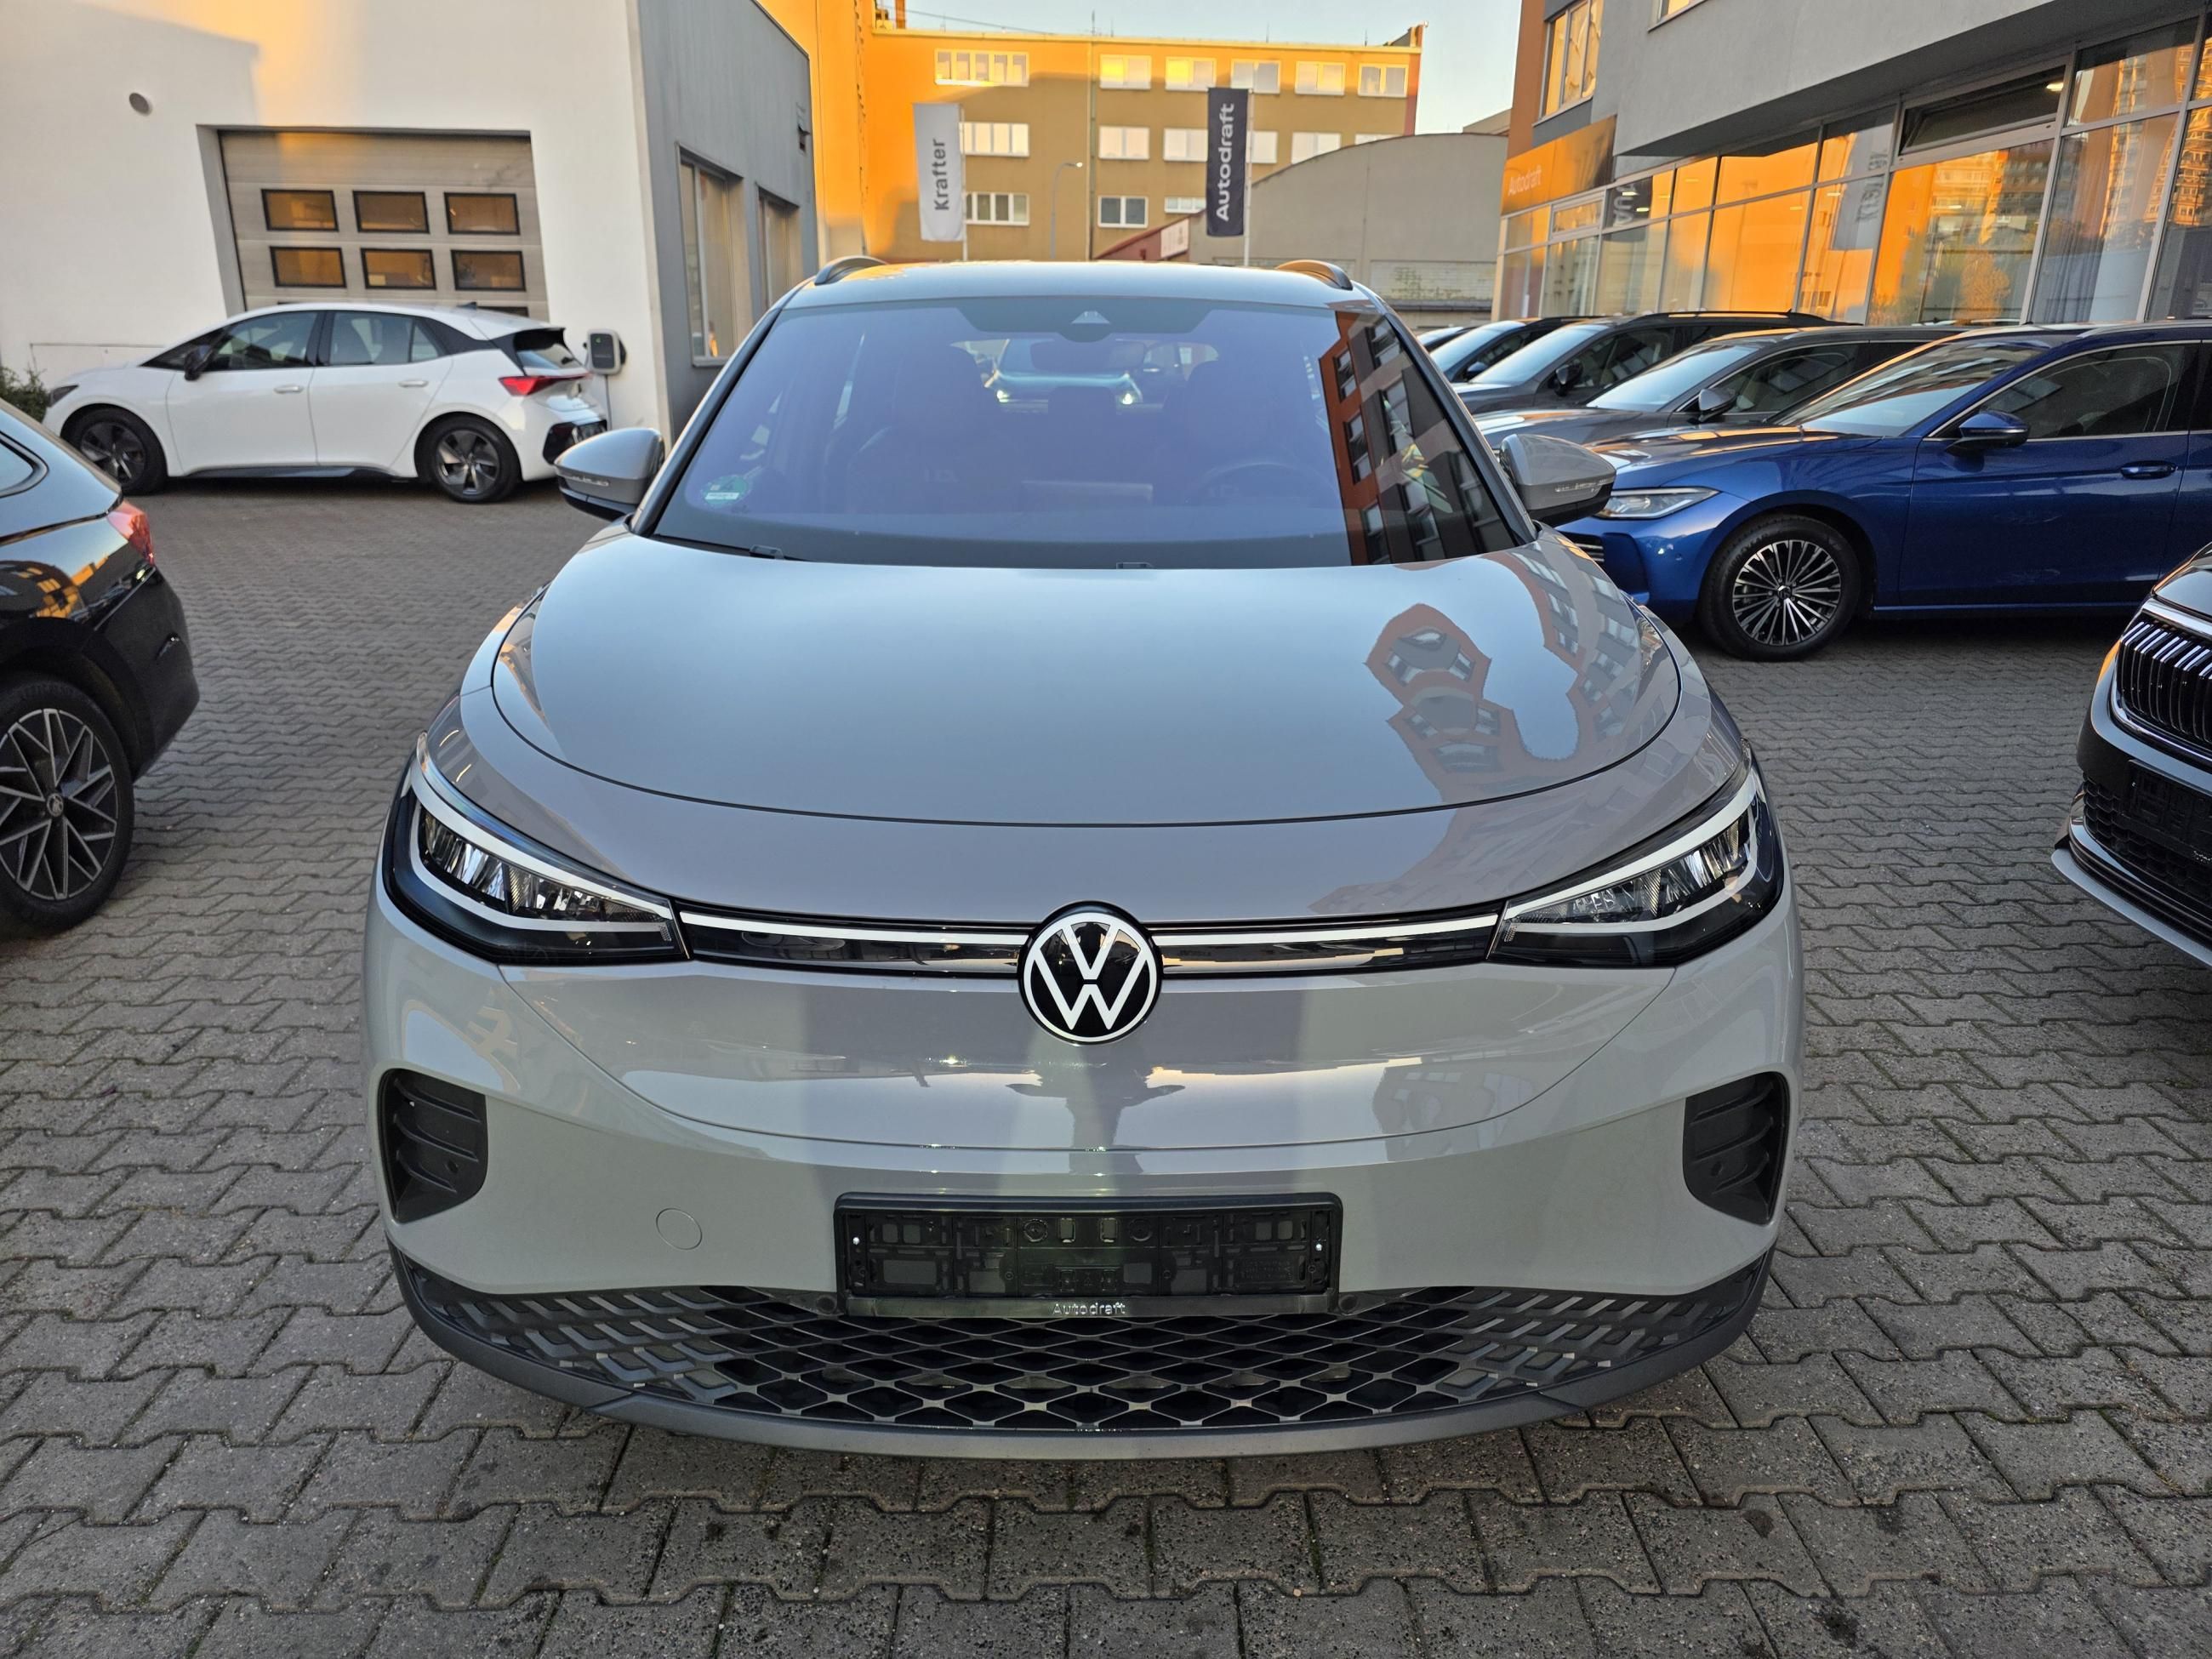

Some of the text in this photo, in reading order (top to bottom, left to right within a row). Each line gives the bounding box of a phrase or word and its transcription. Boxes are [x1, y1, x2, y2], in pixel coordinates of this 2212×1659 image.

[932, 139, 949, 210] Krafter
[1217, 103, 1234, 221] Autodraft
[1052, 1302, 1126, 1315] Autodraft
